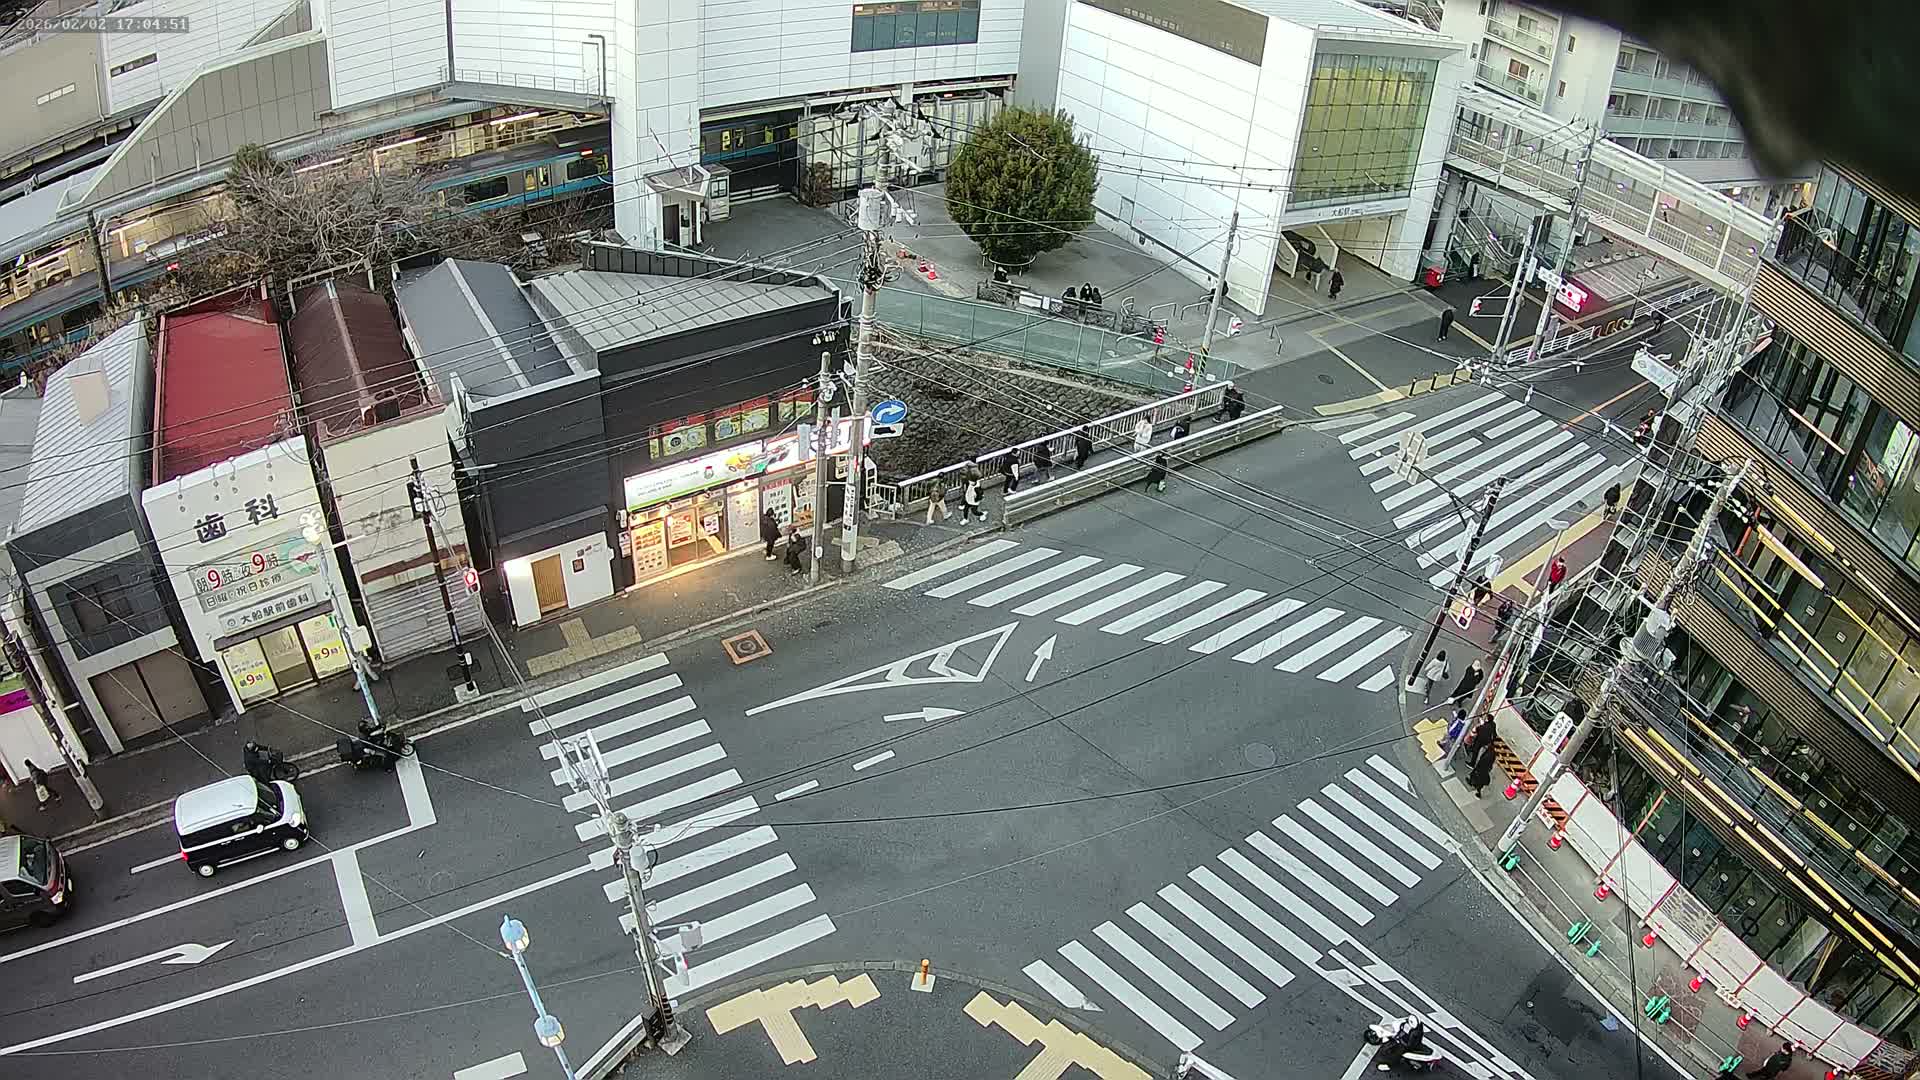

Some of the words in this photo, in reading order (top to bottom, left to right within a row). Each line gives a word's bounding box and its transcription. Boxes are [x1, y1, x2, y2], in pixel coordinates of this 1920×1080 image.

[194, 493, 279, 544] 歯科
[240, 592, 309, 625] 大船駅前歯科
